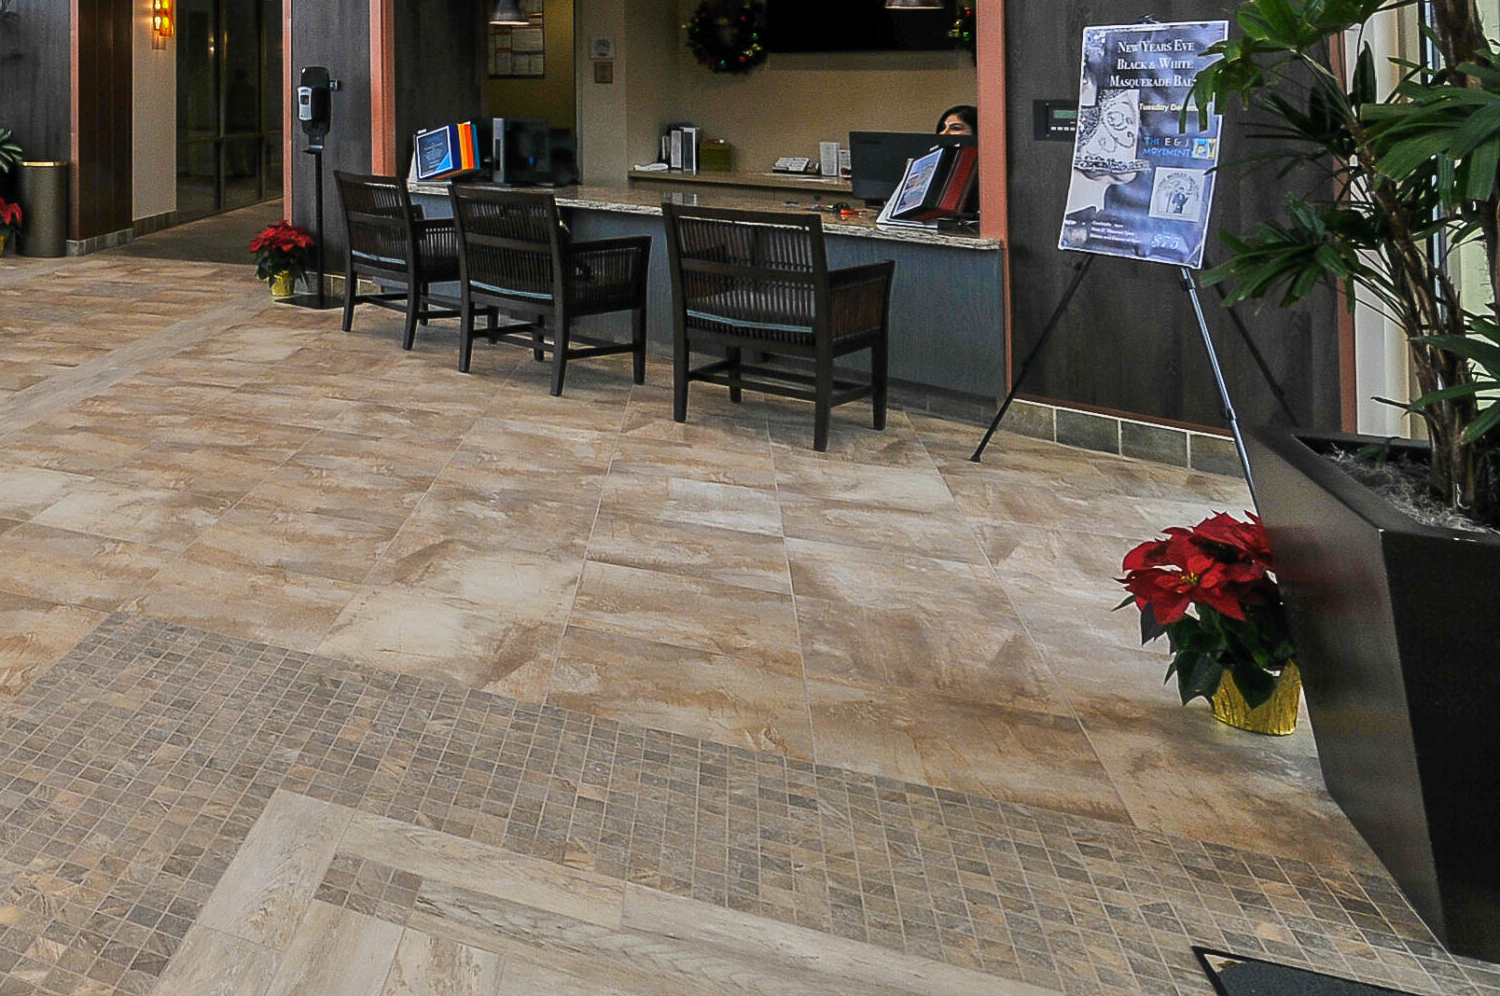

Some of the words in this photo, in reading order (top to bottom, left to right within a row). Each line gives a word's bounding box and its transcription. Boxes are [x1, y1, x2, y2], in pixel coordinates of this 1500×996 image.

[1117, 41, 1138, 53] NEW
[1174, 39, 1195, 52] EVE
[1117, 58, 1148, 70] BLACK
[1158, 57, 1194, 69] WHITE
[1109, 74, 1172, 88] MASQUERADE
[1164, 137, 1171, 146] E
